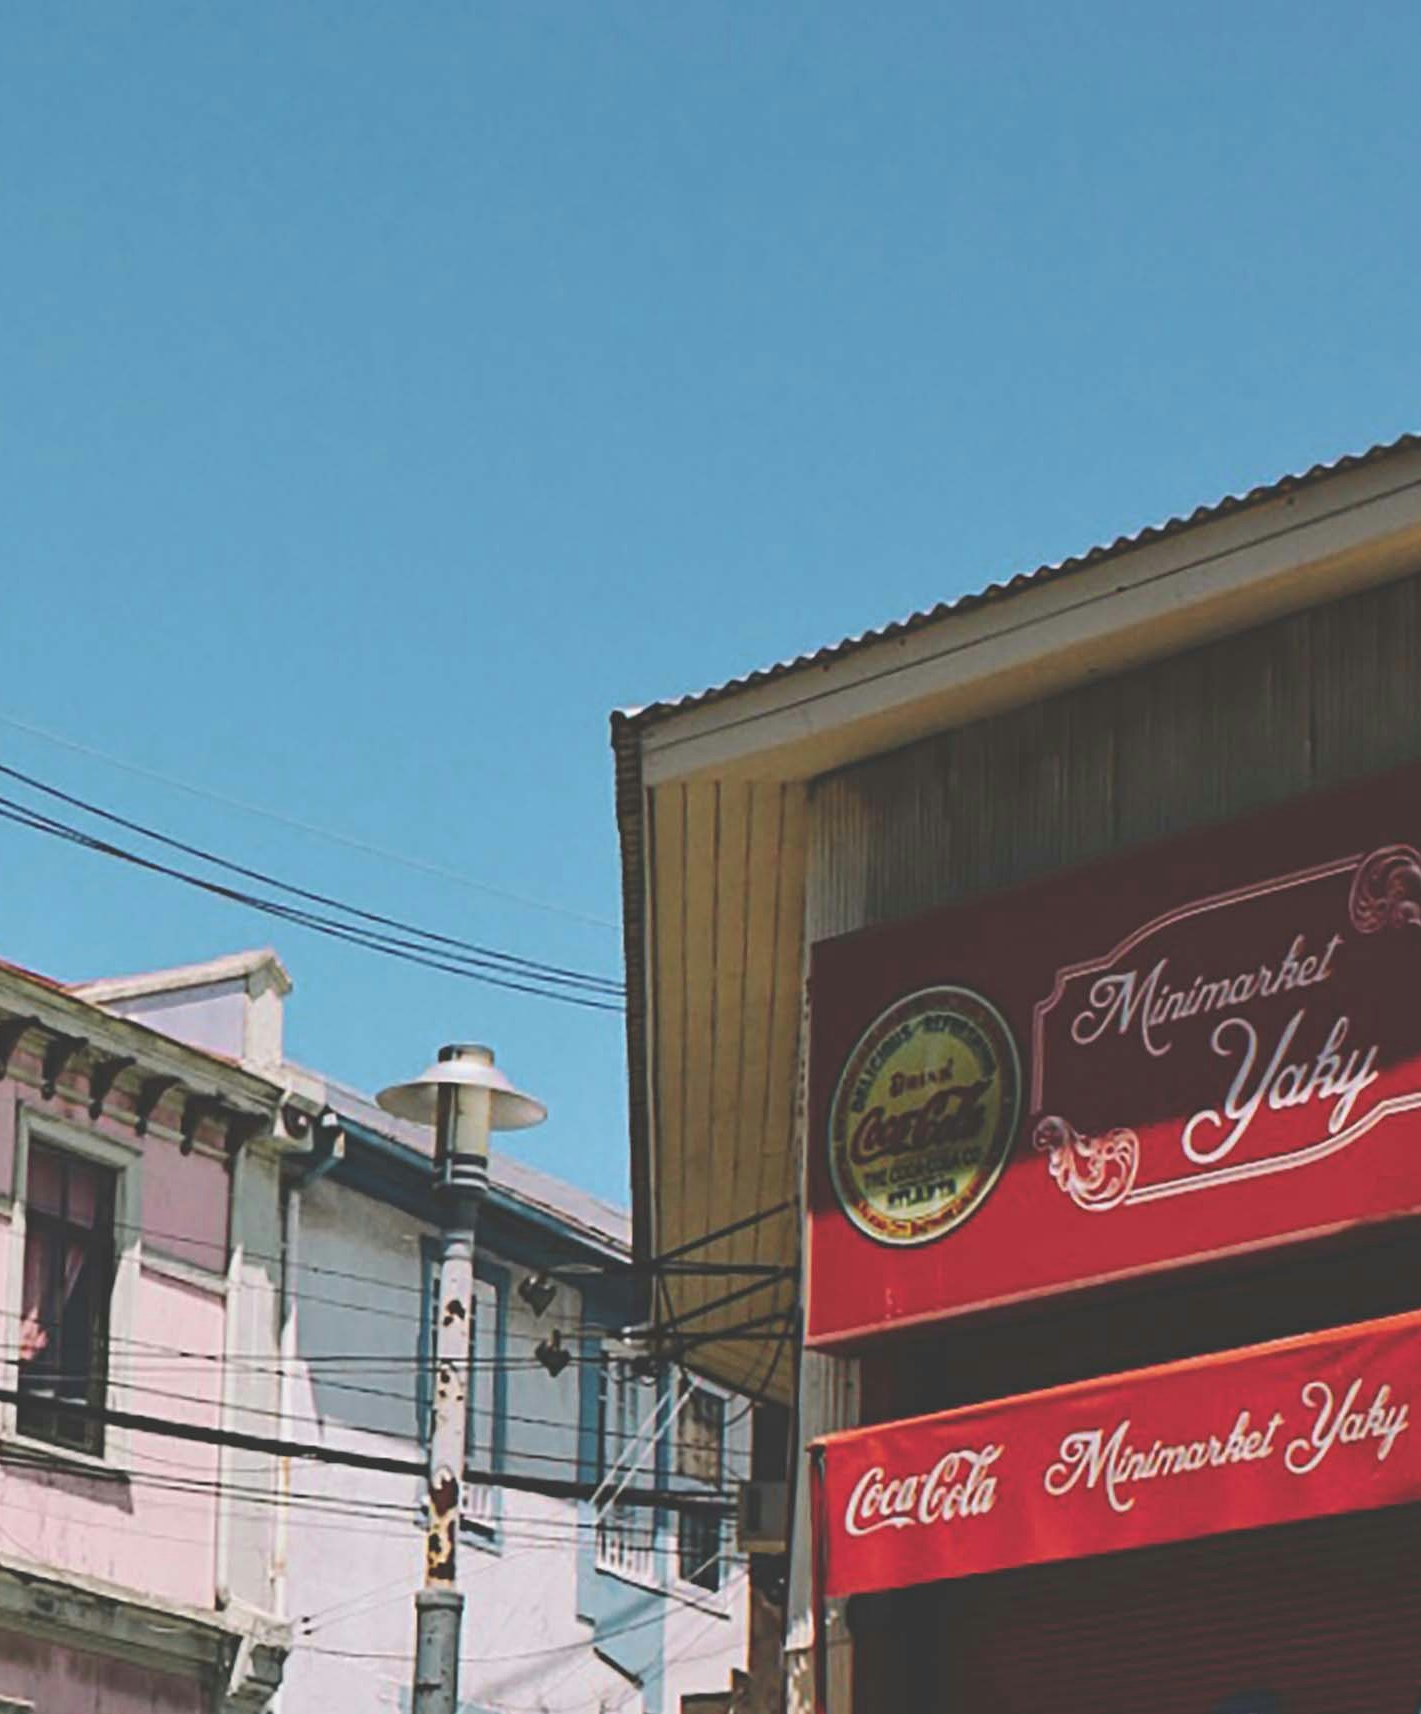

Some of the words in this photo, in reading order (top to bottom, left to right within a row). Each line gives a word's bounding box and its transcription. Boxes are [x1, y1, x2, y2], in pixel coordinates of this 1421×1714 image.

[1071, 934, 1345, 1056] Minimarket
[1182, 1008, 1379, 1164] Yaky
[1044, 1412, 1285, 1513] Minimarket
[1284, 1378, 1409, 1474] Yaky
